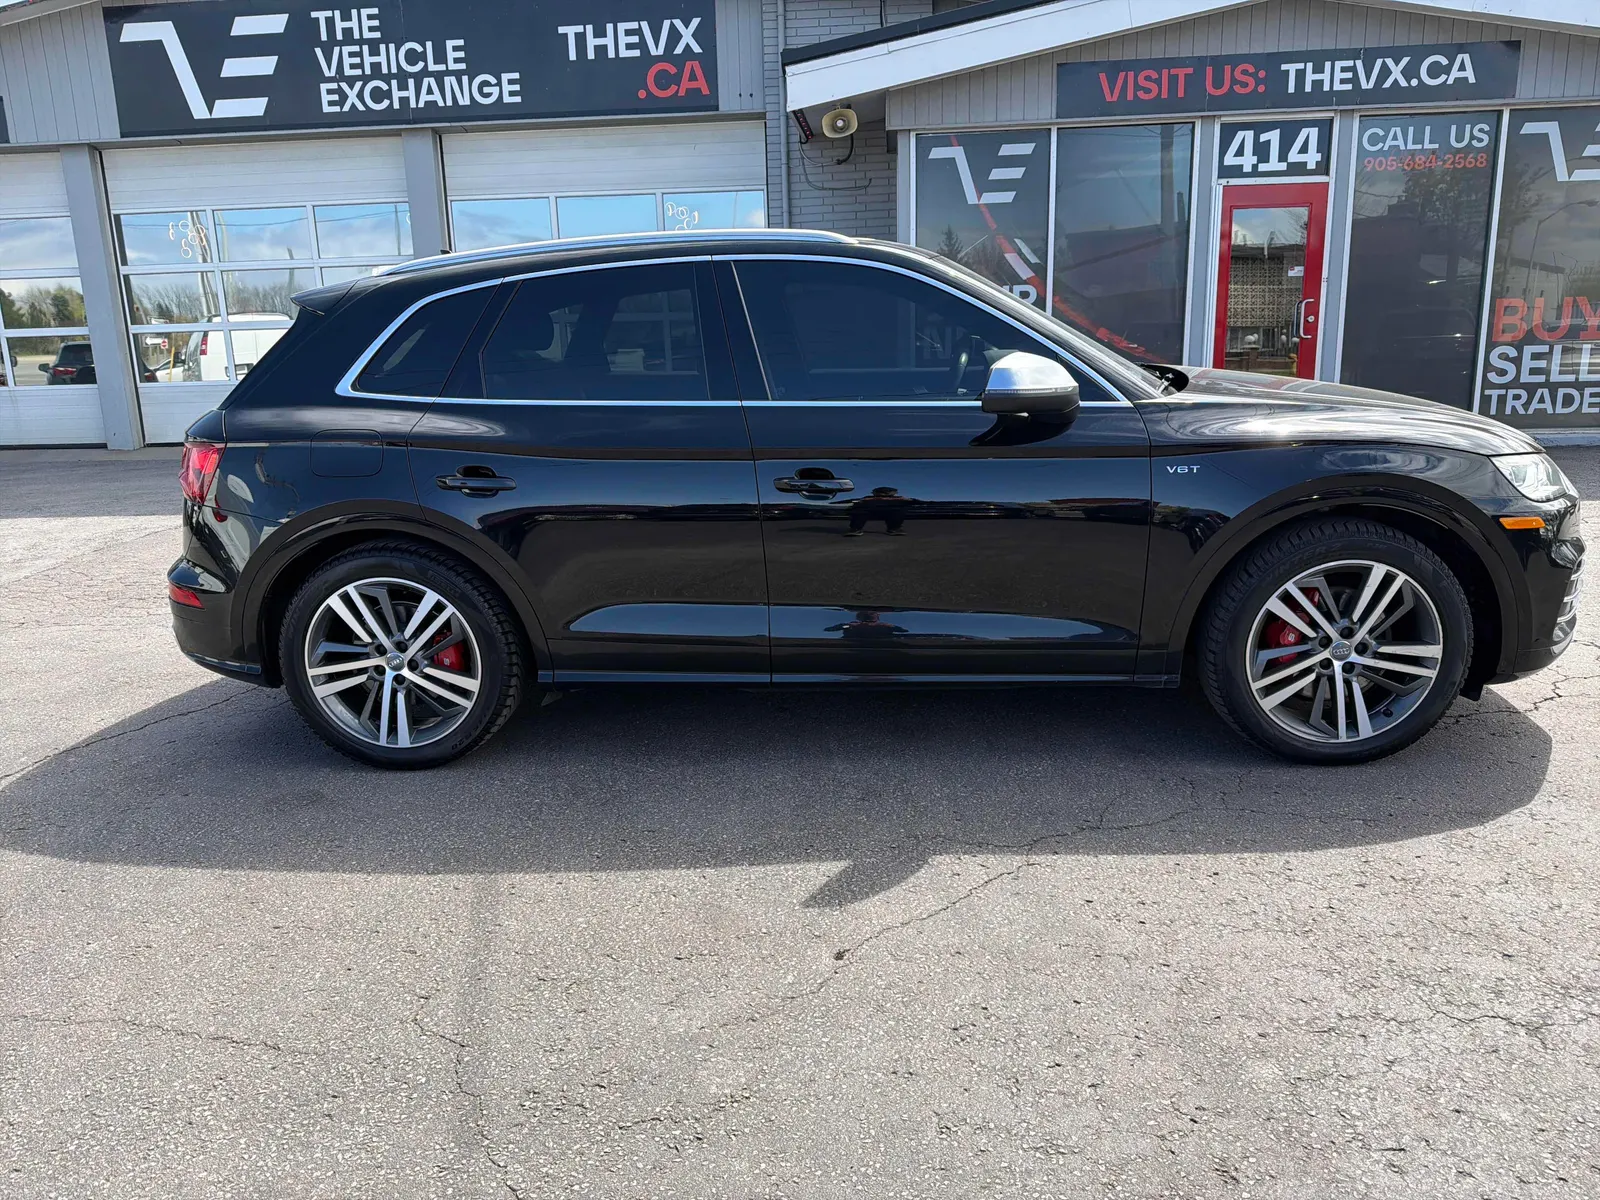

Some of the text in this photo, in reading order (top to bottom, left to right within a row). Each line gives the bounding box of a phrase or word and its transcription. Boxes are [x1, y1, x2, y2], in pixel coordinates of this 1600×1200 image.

[310, 7, 382, 42] THE
[557, 17, 703, 62] THEVX
[314, 38, 468, 78] VEHICLE
[1099, 53, 1476, 103] VISIT US: THEVX.CA
[319, 72, 522, 113] EXCHANGE
[637, 61, 710, 100] .CA
[1223, 127, 1322, 173] 414
[1362, 123, 1490, 151] CALL US
[1364, 153, 1488, 171] 905-684-2568
[1491, 296, 1600, 342] BUY
[1486, 344, 1600, 384] SELL
[1484, 387, 1600, 415] TRADE
[1166, 465, 1201, 474] V6T
